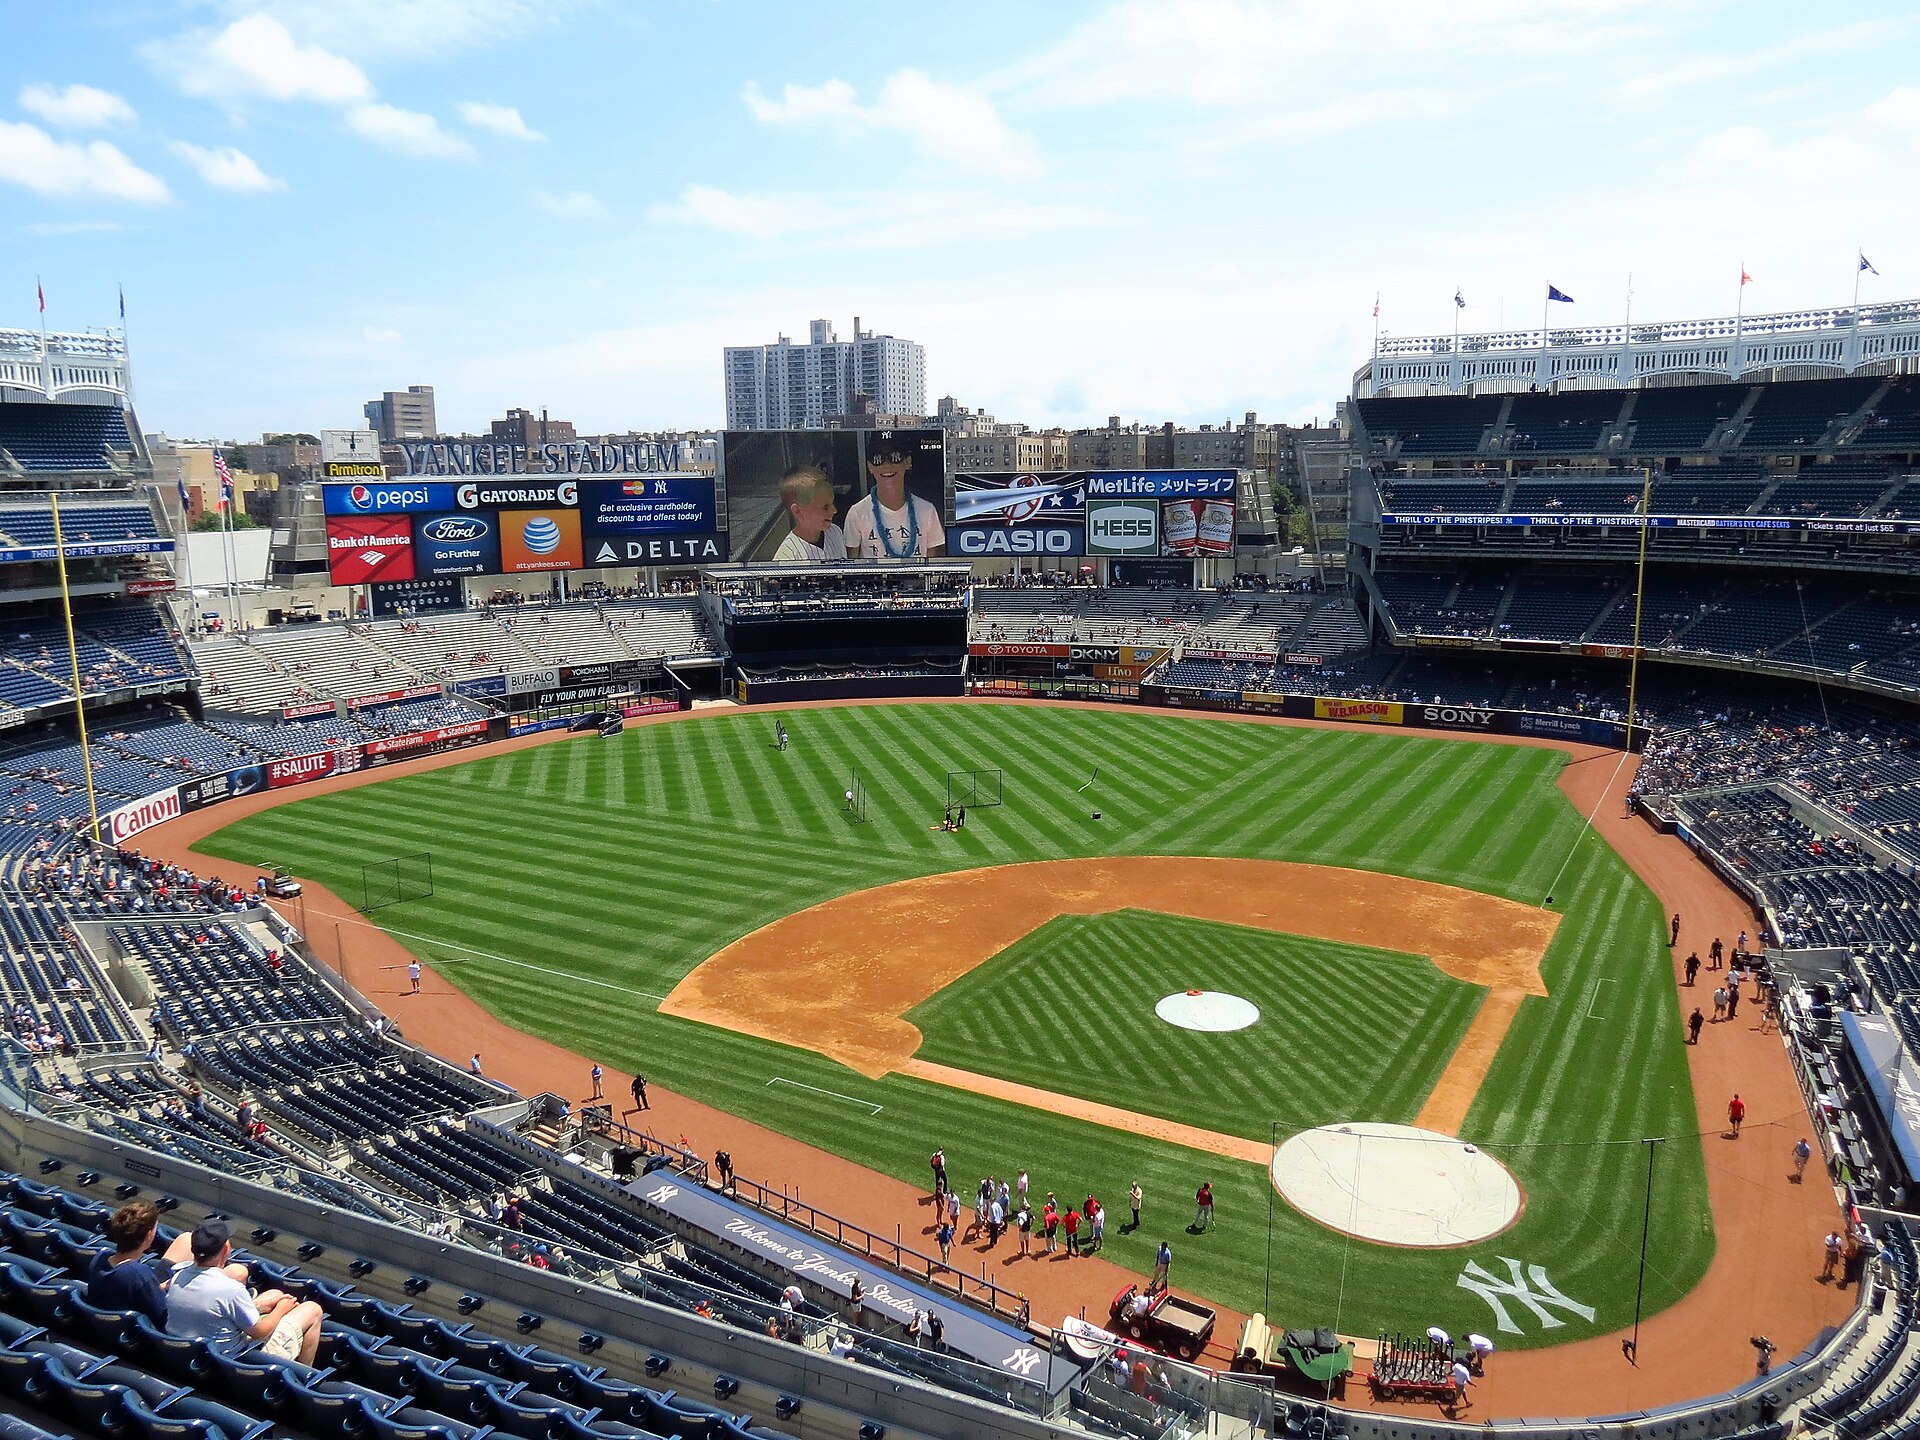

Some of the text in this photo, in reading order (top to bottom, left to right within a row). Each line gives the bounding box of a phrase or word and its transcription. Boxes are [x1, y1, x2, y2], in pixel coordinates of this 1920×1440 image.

[397, 441, 682, 475] YANKEE STADIUM
[329, 463, 380, 476] Armitron
[1088, 475, 1155, 493] MetLife
[1160, 478, 1235, 493] メットライフ
[376, 486, 429, 509] pepsi
[480, 489, 556, 503] GATORADE
[600, 502, 697, 513] Get exclusive cardholder
[597, 511, 703, 523] discounts and offers today!
[1394, 516, 1422, 524] THRILL
[1423, 516, 1435, 524] OF
[1454, 516, 1503, 525] PINSTRIPES!
[1530, 517, 1560, 525] THRILL
[1562, 517, 1575, 525] OF
[1575, 517, 1593, 525] THE
[1596, 517, 1648, 526] PINSTRIPES!
[1677, 518, 1716, 527] MASTERCARD
[1772, 521, 1791, 529] SEATS
[435, 519, 476, 539] Ford
[1093, 519, 1152, 536] HESS
[1807, 522, 1833, 530] Tickets
[1835, 523, 1854, 531] start
[1864, 523, 1879, 533] just
[1880, 524, 1895, 533] $65
[329, 533, 411, 549] Bank of America
[960, 530, 1071, 553] CASIO
[31, 549, 59, 559] THRIL
[64, 547, 77, 556] OF
[79, 546, 96, 555] THE
[98, 543, 150, 554] PINSTRIPES!
[435, 549, 481, 560] Go Further
[626, 543, 719, 565] DELTA
[516, 560, 571, 570] attyankees.com
[1005, 645, 1048, 654] TOYOTA
[1070, 648, 1119, 661] DKNY
[1133, 650, 1153, 661] SAP
[1056, 662, 1075, 670] FedEx
[1288, 655, 1319, 663] MODELL'S
[571, 665, 610, 676] YOKOHAMA
[511, 671, 555, 687] BUFFALO
[540, 693, 555, 704] FLY
[556, 690, 577, 701] YOUR
[578, 688, 597, 699] OWN
[597, 685, 616, 696] FLAG
[1423, 707, 1495, 725] SONY
[446, 723, 481, 737] StateFarm
[1535, 718, 1581, 730] Merrill Lynch
[386, 735, 423, 750] StateFarm
[271, 754, 327, 779] #SALUTE
[201, 781, 213, 791] PLAY
[201, 787, 214, 798] STAY
[113, 793, 179, 839] Canon
[724, 1217, 789, 1255] Welcome
[786, 1249, 807, 1261] to
[792, 1252, 862, 1287] Yanke
